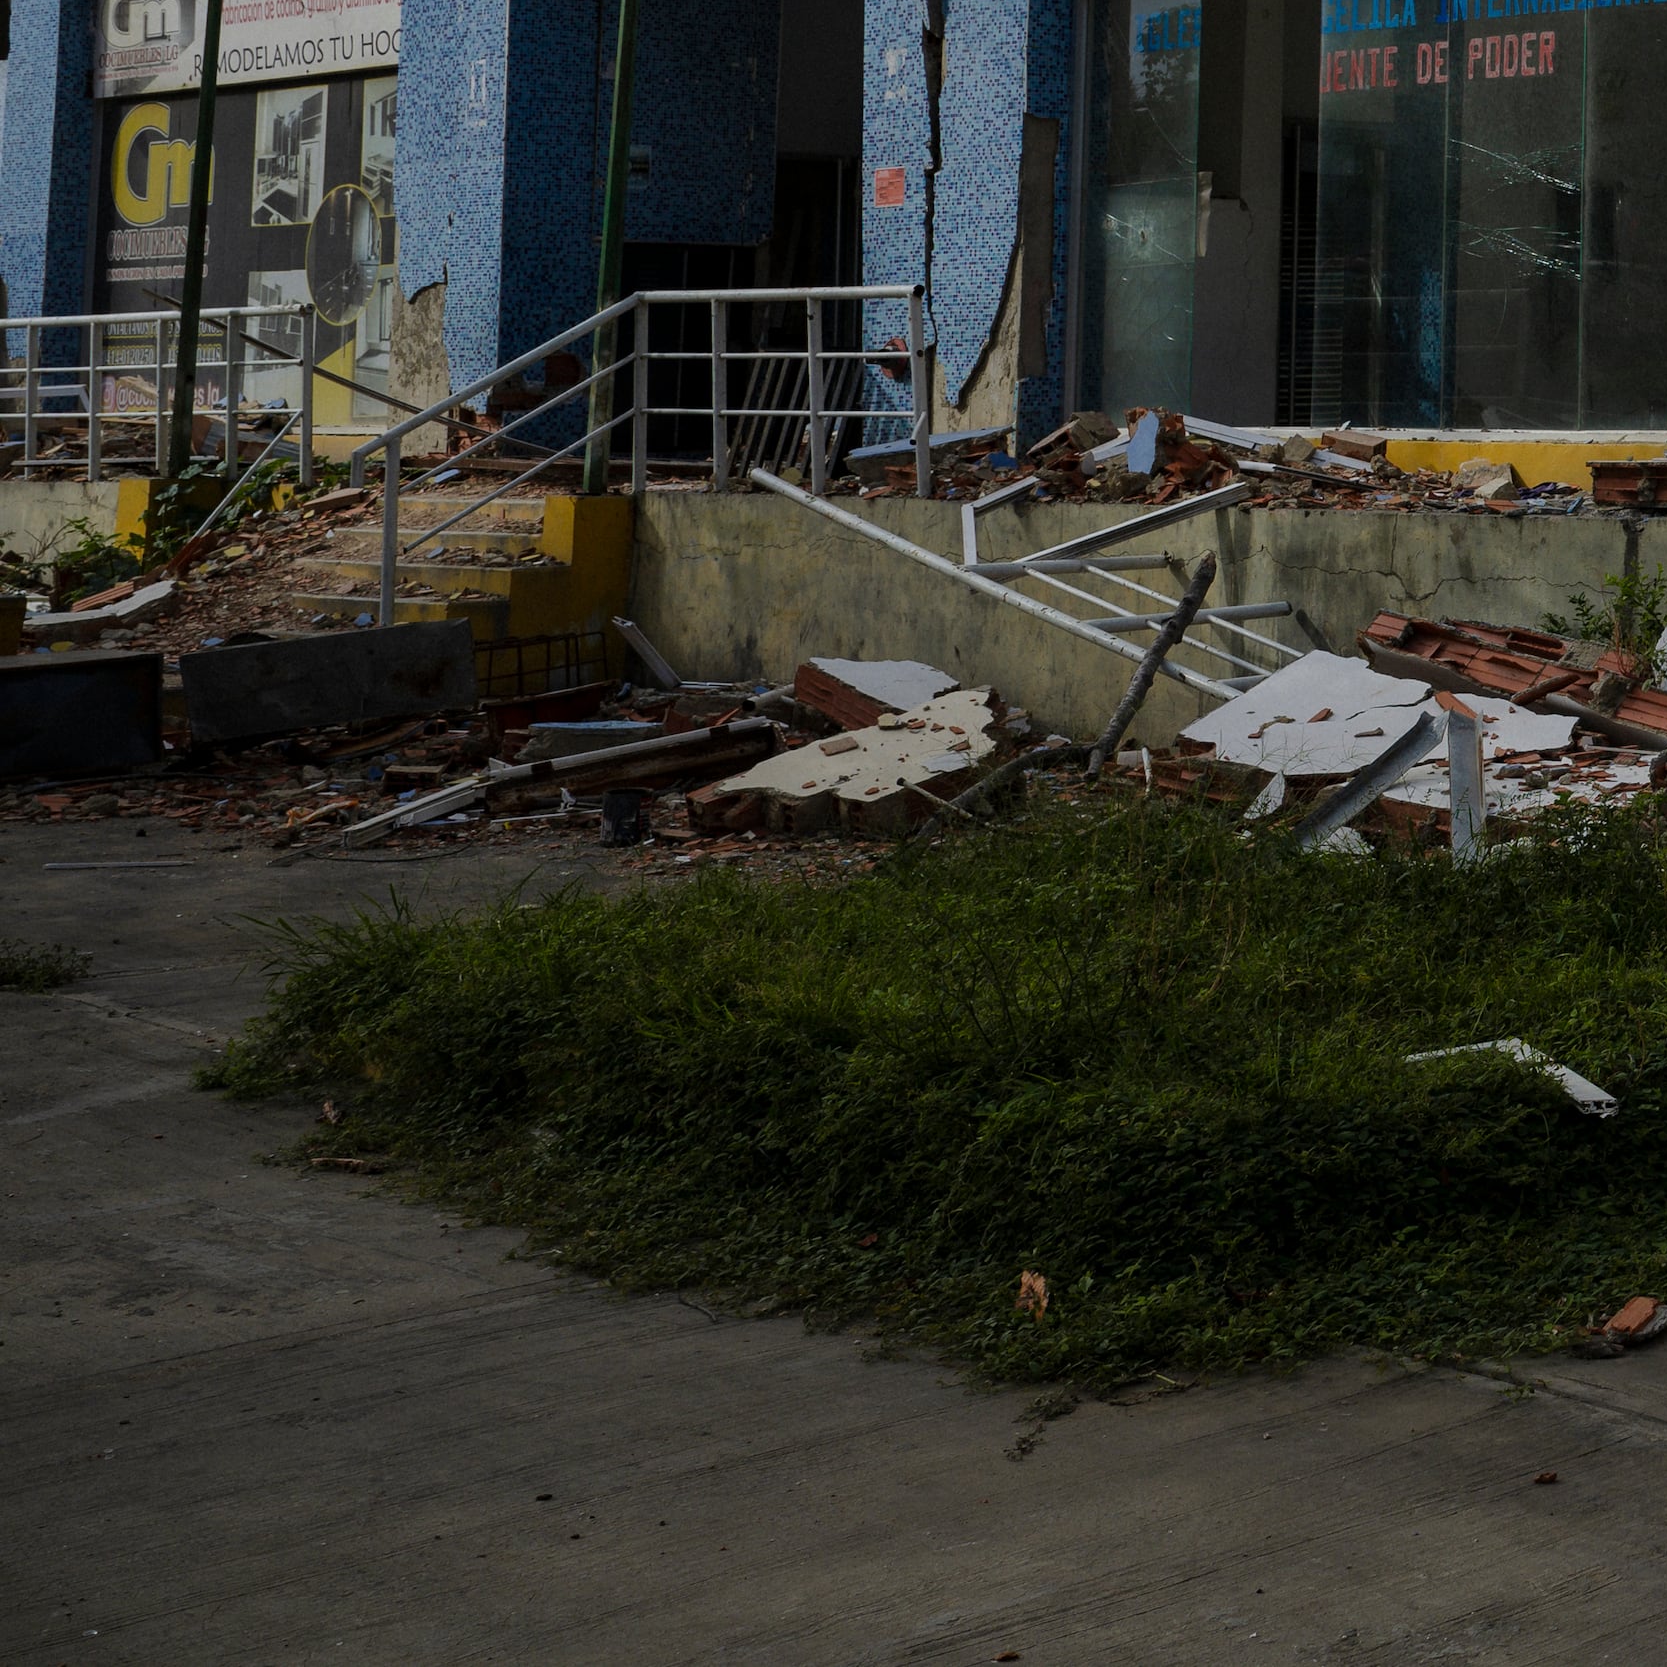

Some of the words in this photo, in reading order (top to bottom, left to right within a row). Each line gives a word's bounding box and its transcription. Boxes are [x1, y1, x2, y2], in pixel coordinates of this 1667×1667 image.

[166, 44, 179, 62] LG
[194, 38, 324, 78] RMODELAMOS
[329, 35, 353, 62] TU
[1416, 40, 1449, 85] DE
[1468, 30, 1556, 81] PODER
